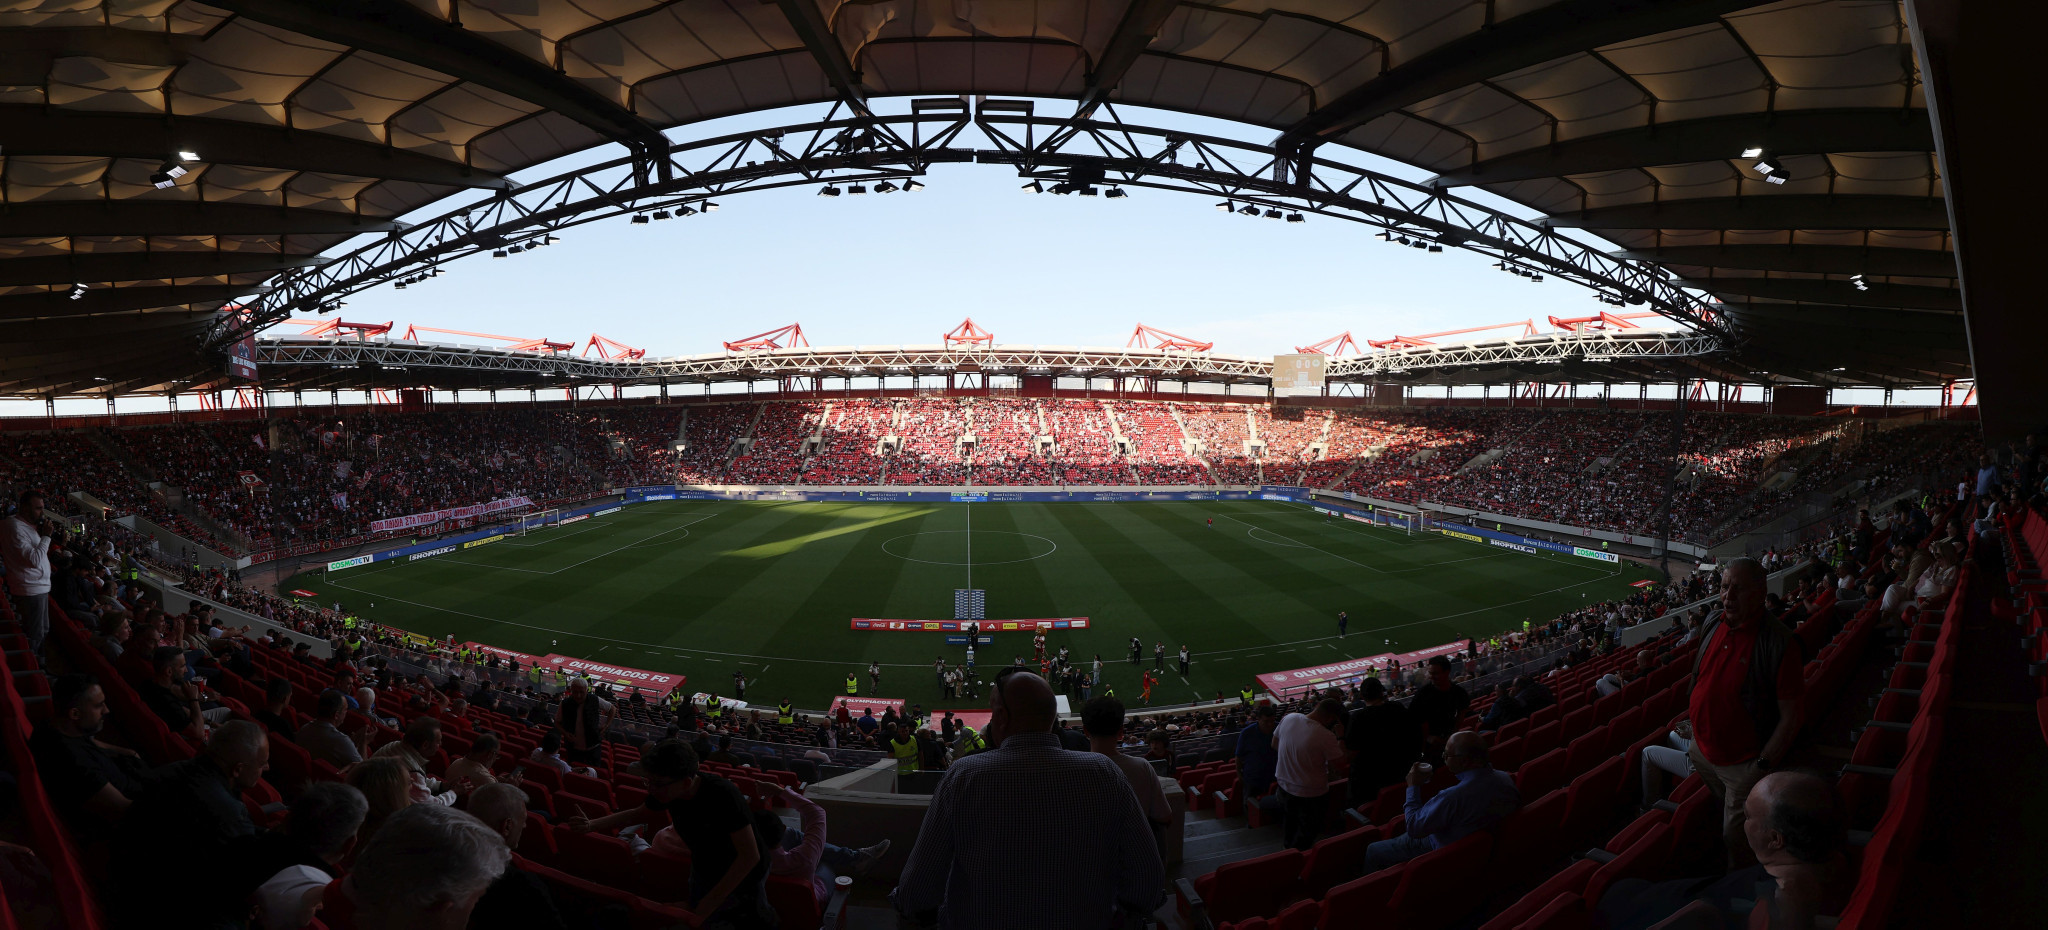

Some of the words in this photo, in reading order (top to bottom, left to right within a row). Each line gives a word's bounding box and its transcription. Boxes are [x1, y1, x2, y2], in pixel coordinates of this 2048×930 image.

[331, 557, 363, 570] COSMOTE
[363, 556, 370, 564] TV
[1576, 548, 1607, 560] COSMOTE
[1608, 553, 1616, 561] TV
[569, 660, 650, 680] OLYMPIACOS
[650, 674, 670, 683] FC
[1293, 659, 1374, 678] OLYMPIACOS
[1372, 656, 1388, 664] FC
